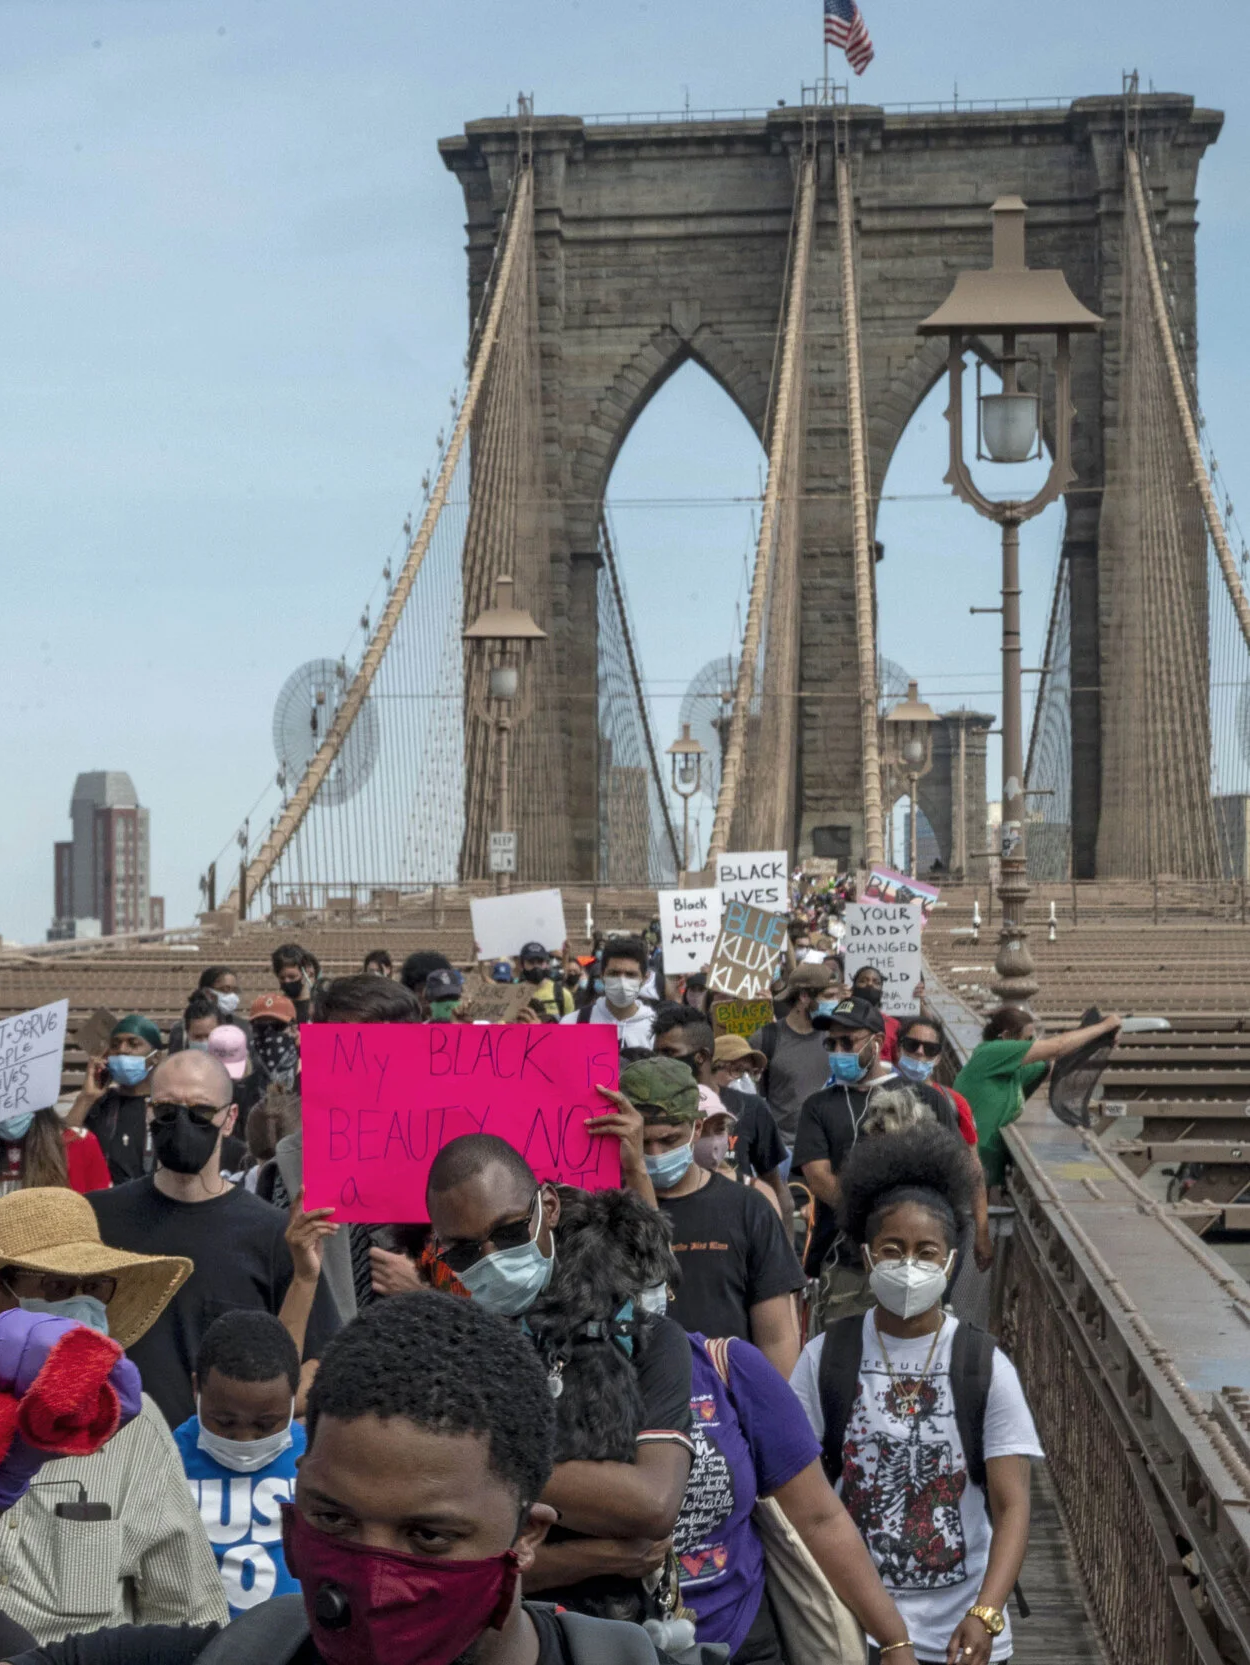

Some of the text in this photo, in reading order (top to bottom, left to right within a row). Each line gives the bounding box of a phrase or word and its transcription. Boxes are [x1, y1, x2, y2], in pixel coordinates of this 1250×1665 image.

[720, 862, 786, 882] BLACK
[673, 896, 708, 911] Black
[721, 888, 779, 906] LIVES
[860, 907, 911, 920] YOUR
[674, 915, 707, 929] Lives
[725, 901, 788, 950] BLUE
[851, 923, 914, 937] DADDY
[671, 931, 716, 945] Matter
[717, 932, 781, 977] KLUX
[846, 942, 919, 954] CHANGED
[867, 957, 895, 968] THE
[708, 962, 770, 1000] KLAN
[12, 1010, 58, 1042] SERVE
[728, 1020, 769, 1034] LIVE
[429, 1027, 555, 1085] BLACK
[586, 1052, 616, 1090] IS
[328, 1105, 491, 1163] BEAUTY
